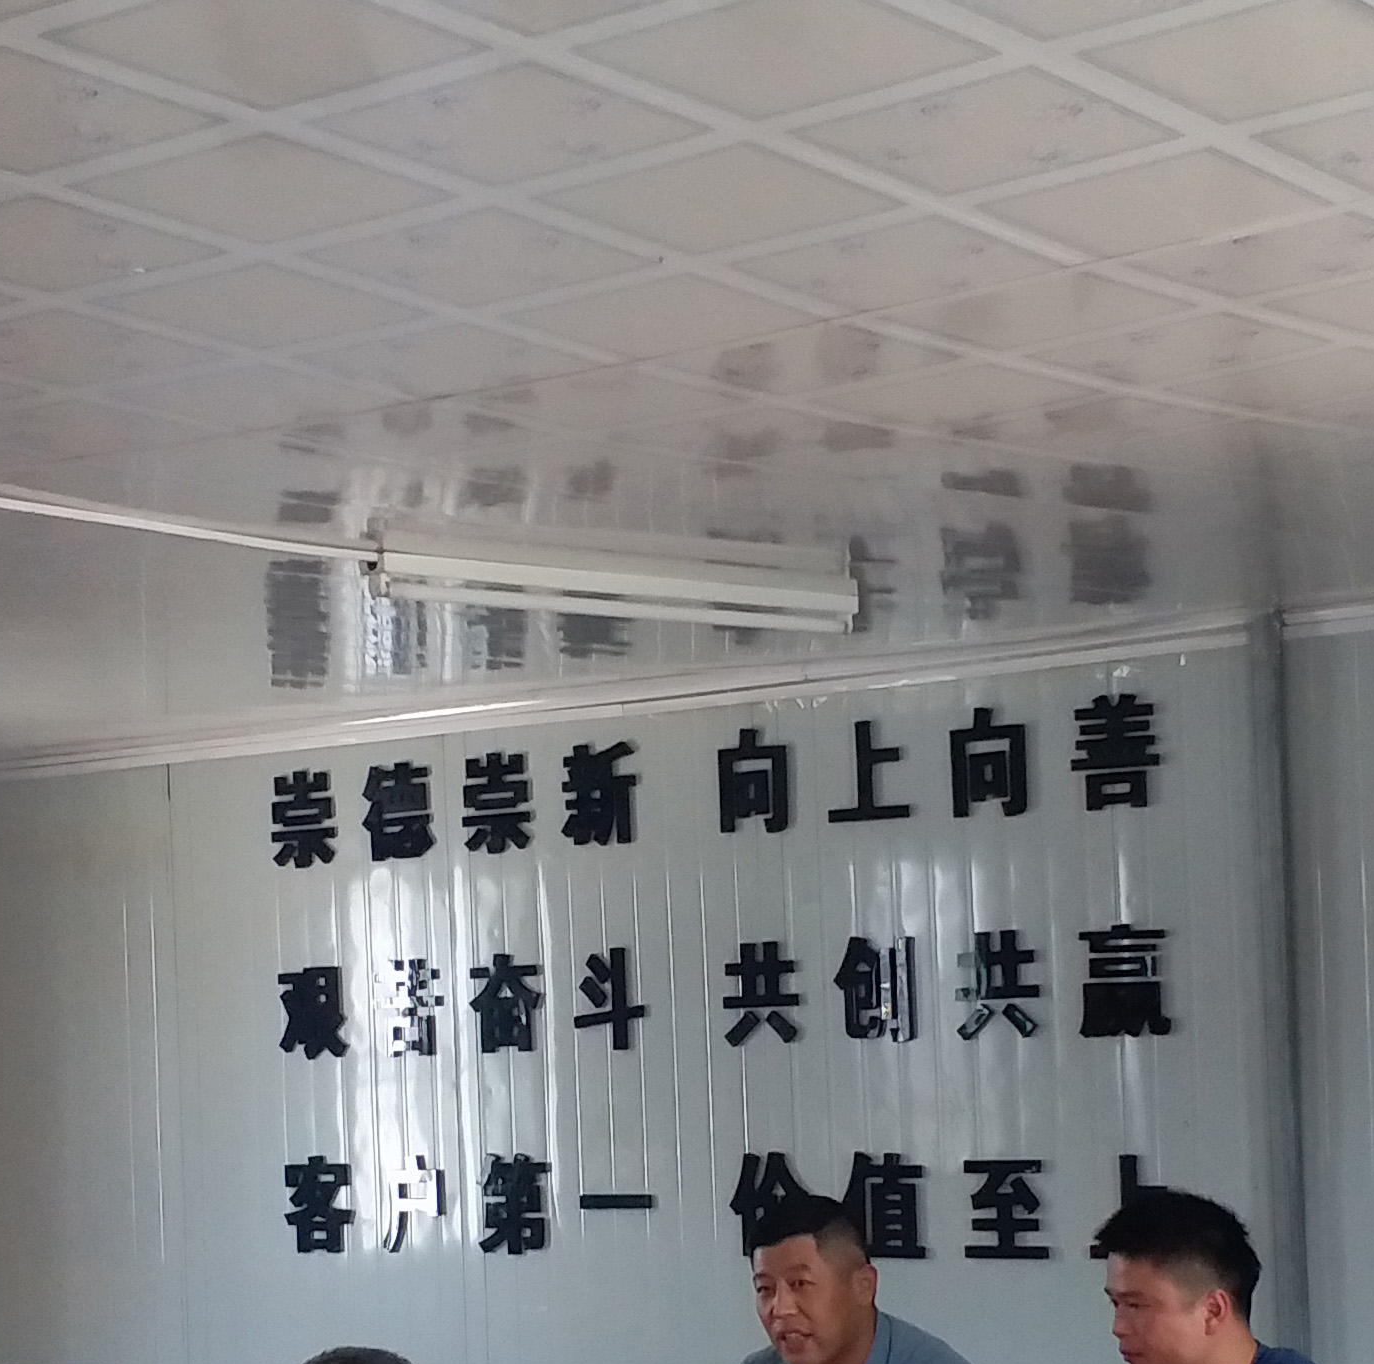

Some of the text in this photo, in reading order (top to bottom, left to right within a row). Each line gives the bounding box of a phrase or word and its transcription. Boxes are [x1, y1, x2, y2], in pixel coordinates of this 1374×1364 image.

[271, 693, 1161, 868] 崇德崇新 向上向善
[277, 922, 1172, 1060] 艰苦奋斗 共创共赢
[285, 1153, 654, 1256] 客户第一
